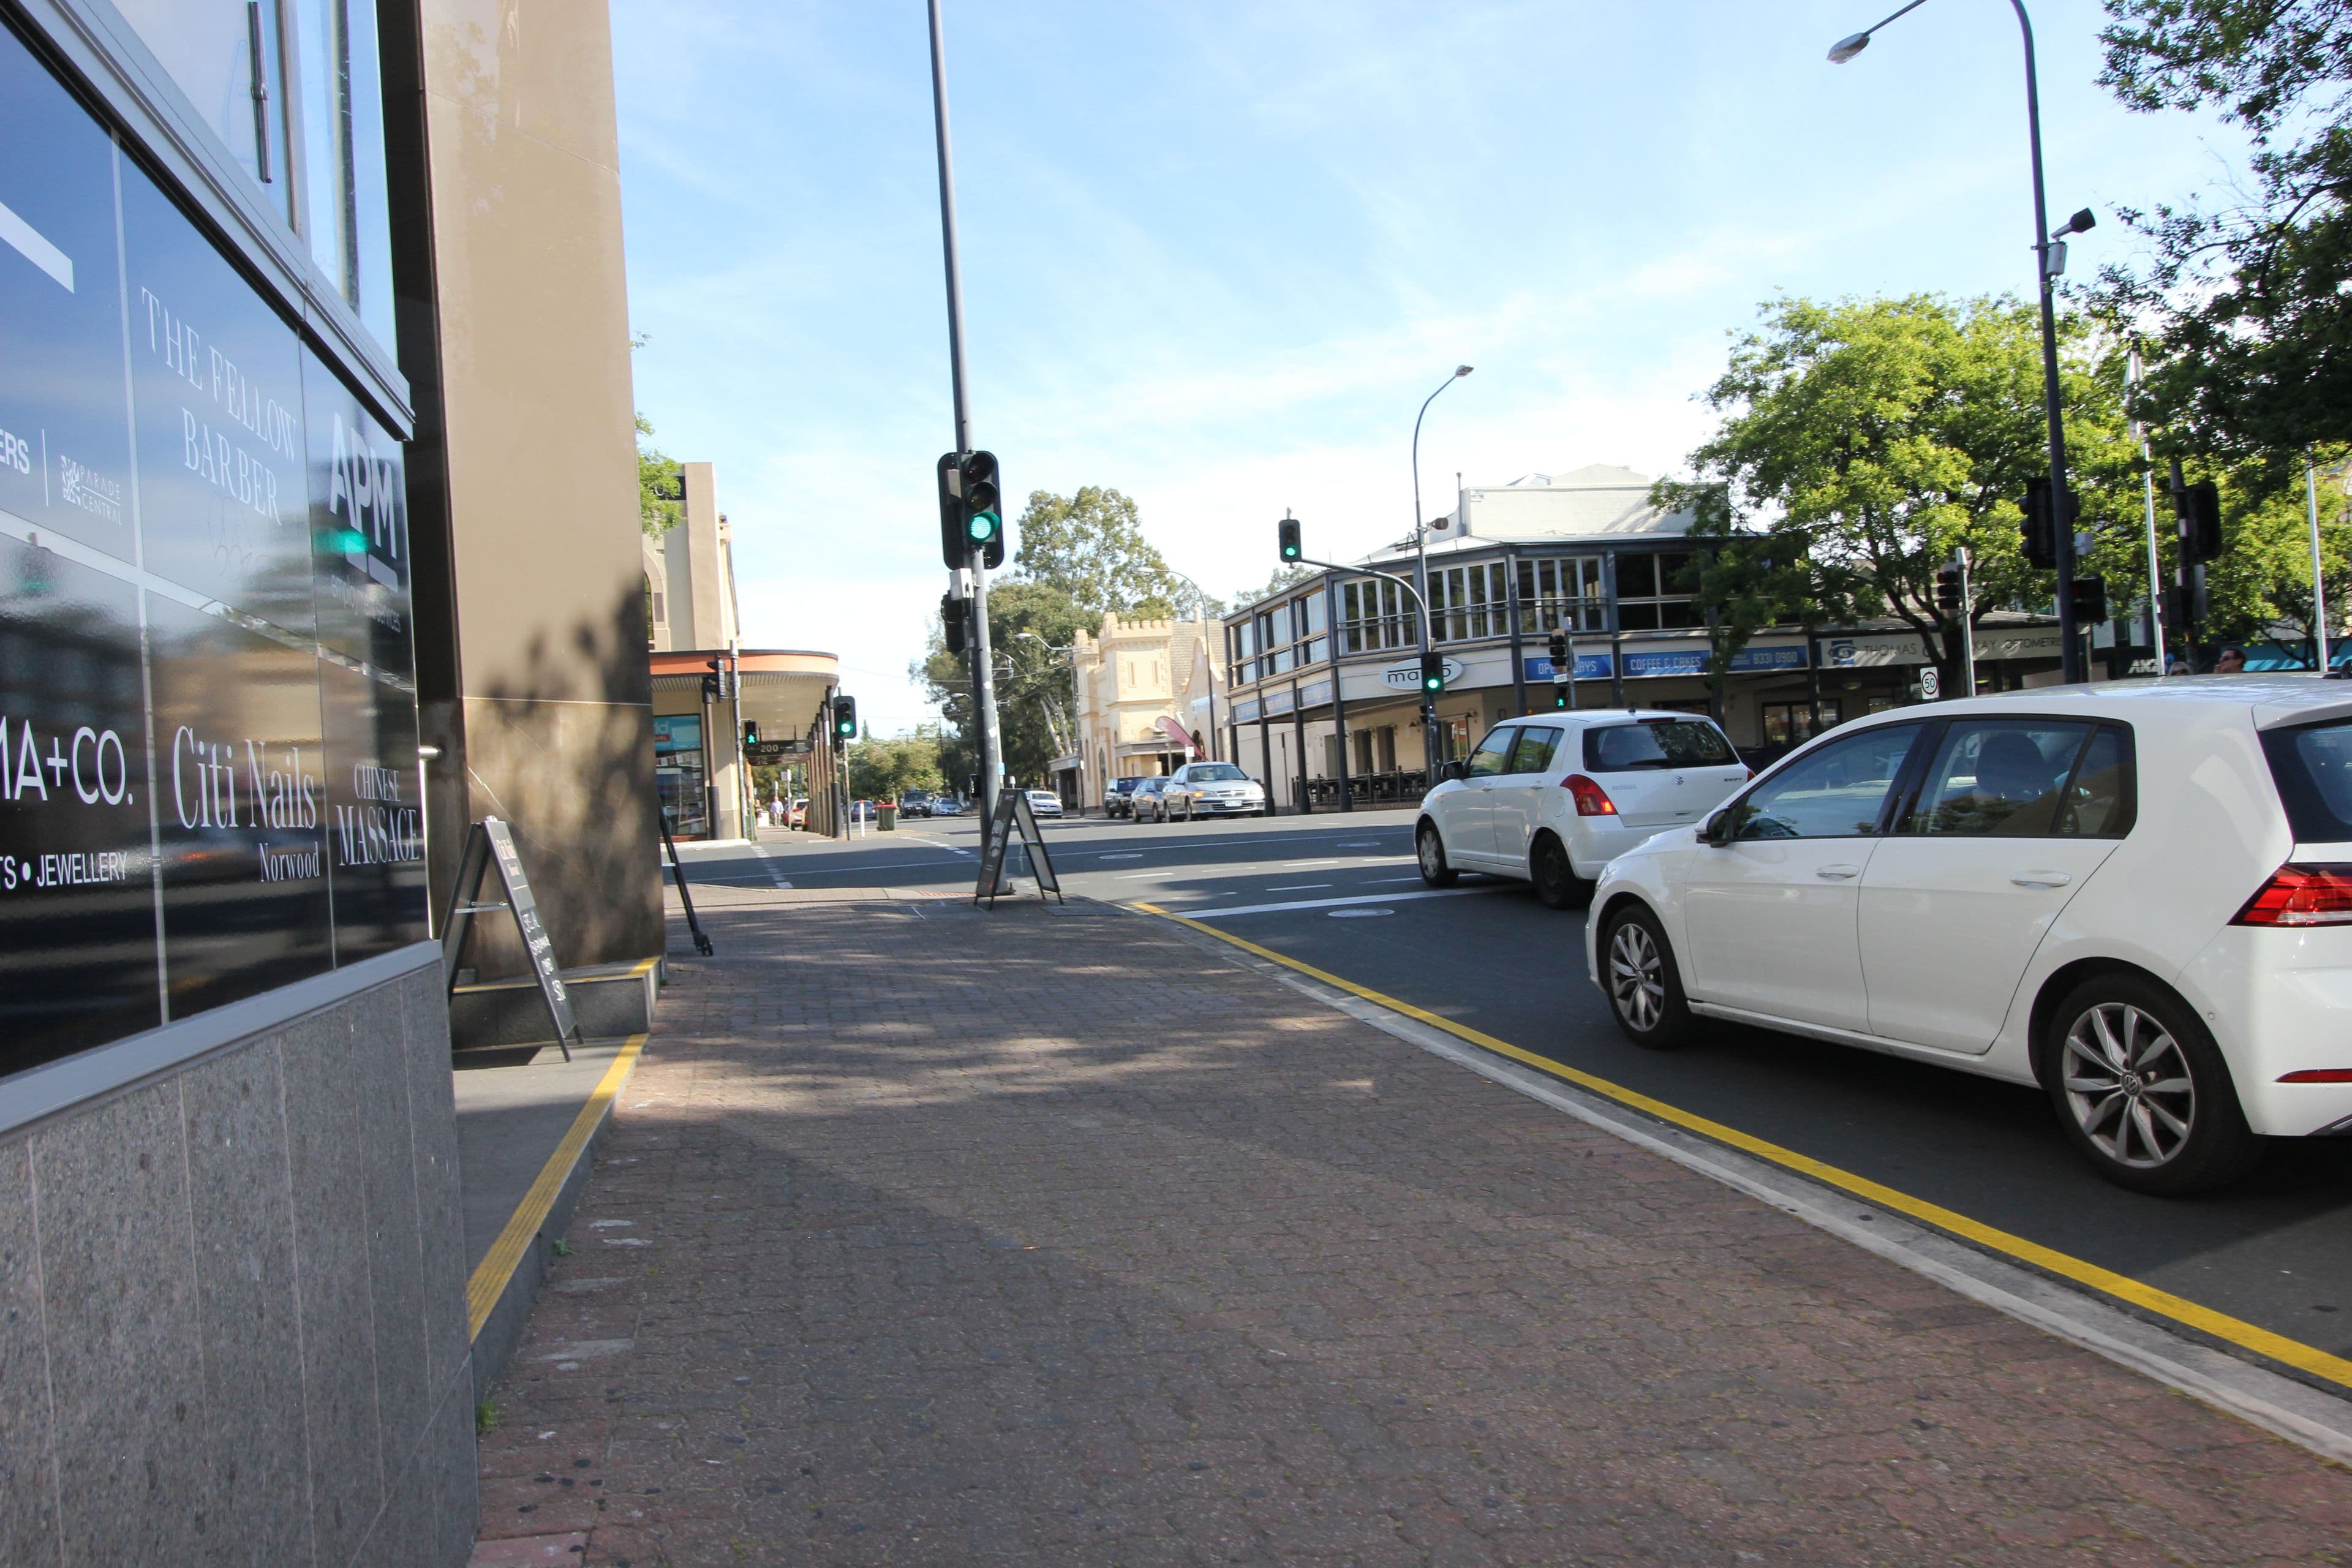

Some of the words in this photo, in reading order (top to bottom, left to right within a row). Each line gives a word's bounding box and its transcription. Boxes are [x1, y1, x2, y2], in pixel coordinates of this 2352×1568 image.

[142, 286, 202, 391] THE
[209, 345, 296, 464] FELLOW
[80, 465, 121, 500] PARADE
[182, 407, 282, 526] BARBER
[330, 412, 397, 559] APM
[83, 494, 123, 526] CENTRAL
[1630, 658, 1662, 671] COFFEE
[1673, 656, 1702, 668] CAKES
[1924, 678, 1936, 689] 50
[760, 744, 779, 753] 200
[173, 725, 239, 829] Citi
[245, 739, 317, 829] Nails
[354, 763, 402, 802] CHINESE
[336, 805, 420, 866] MASSAGE
[37, 851, 128, 888] JEWELLERY
[259, 842, 320, 882] Norwood
